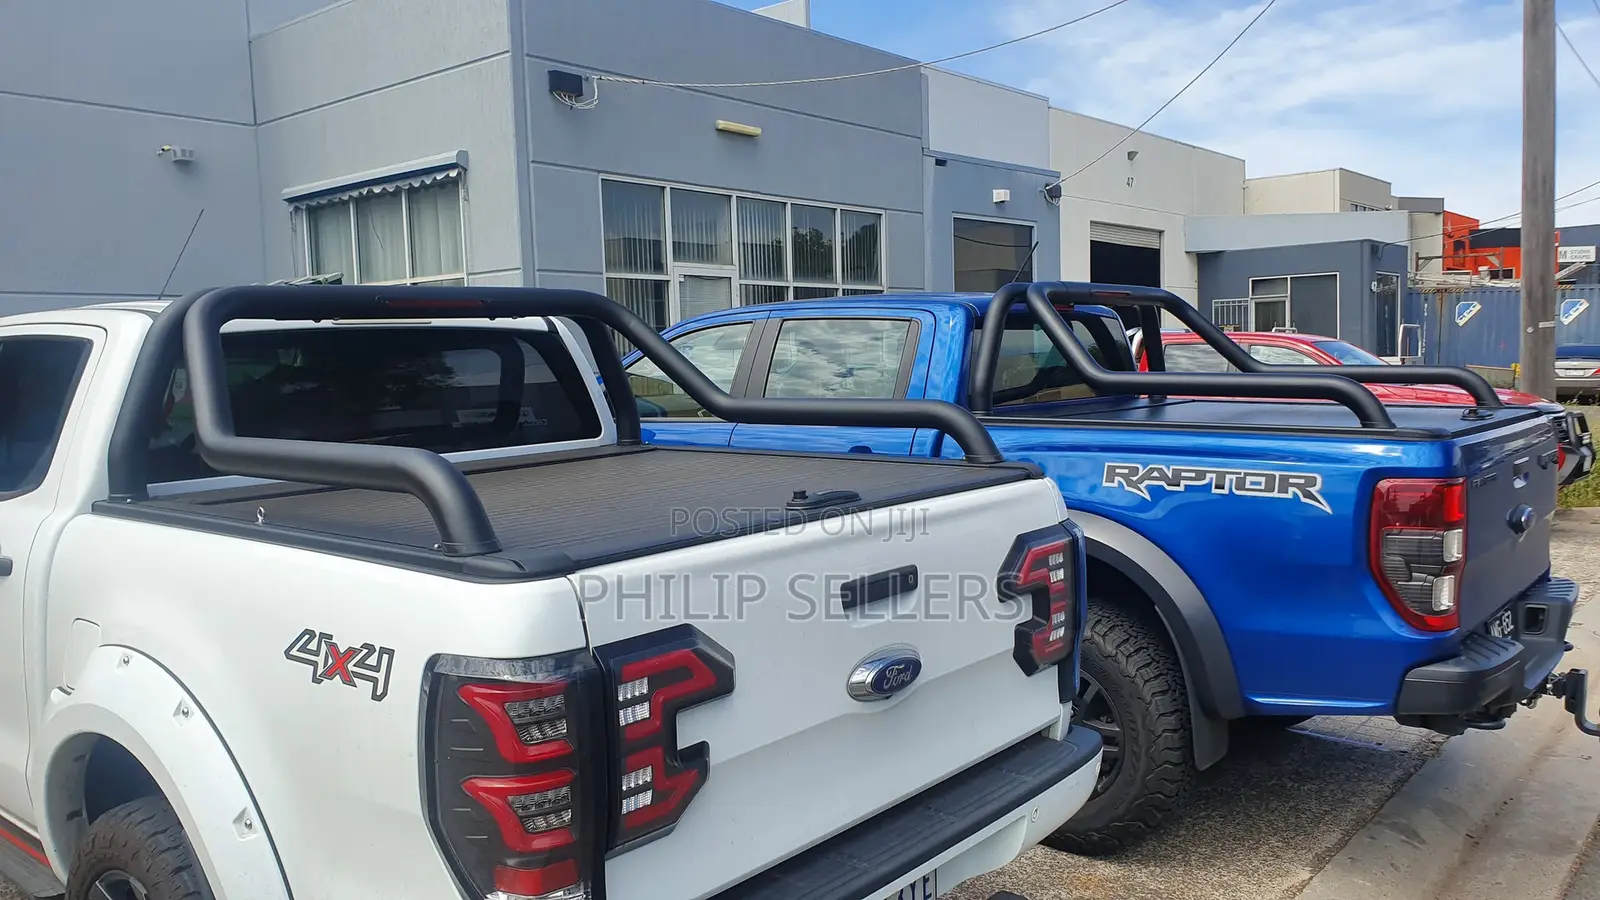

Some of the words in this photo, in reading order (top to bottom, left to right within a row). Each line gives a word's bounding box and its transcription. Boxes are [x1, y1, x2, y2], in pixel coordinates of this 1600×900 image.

[1126, 176, 1134, 188] 47
[1102, 462, 1333, 515] RAPTOR
[883, 663, 913, 690] Ford
